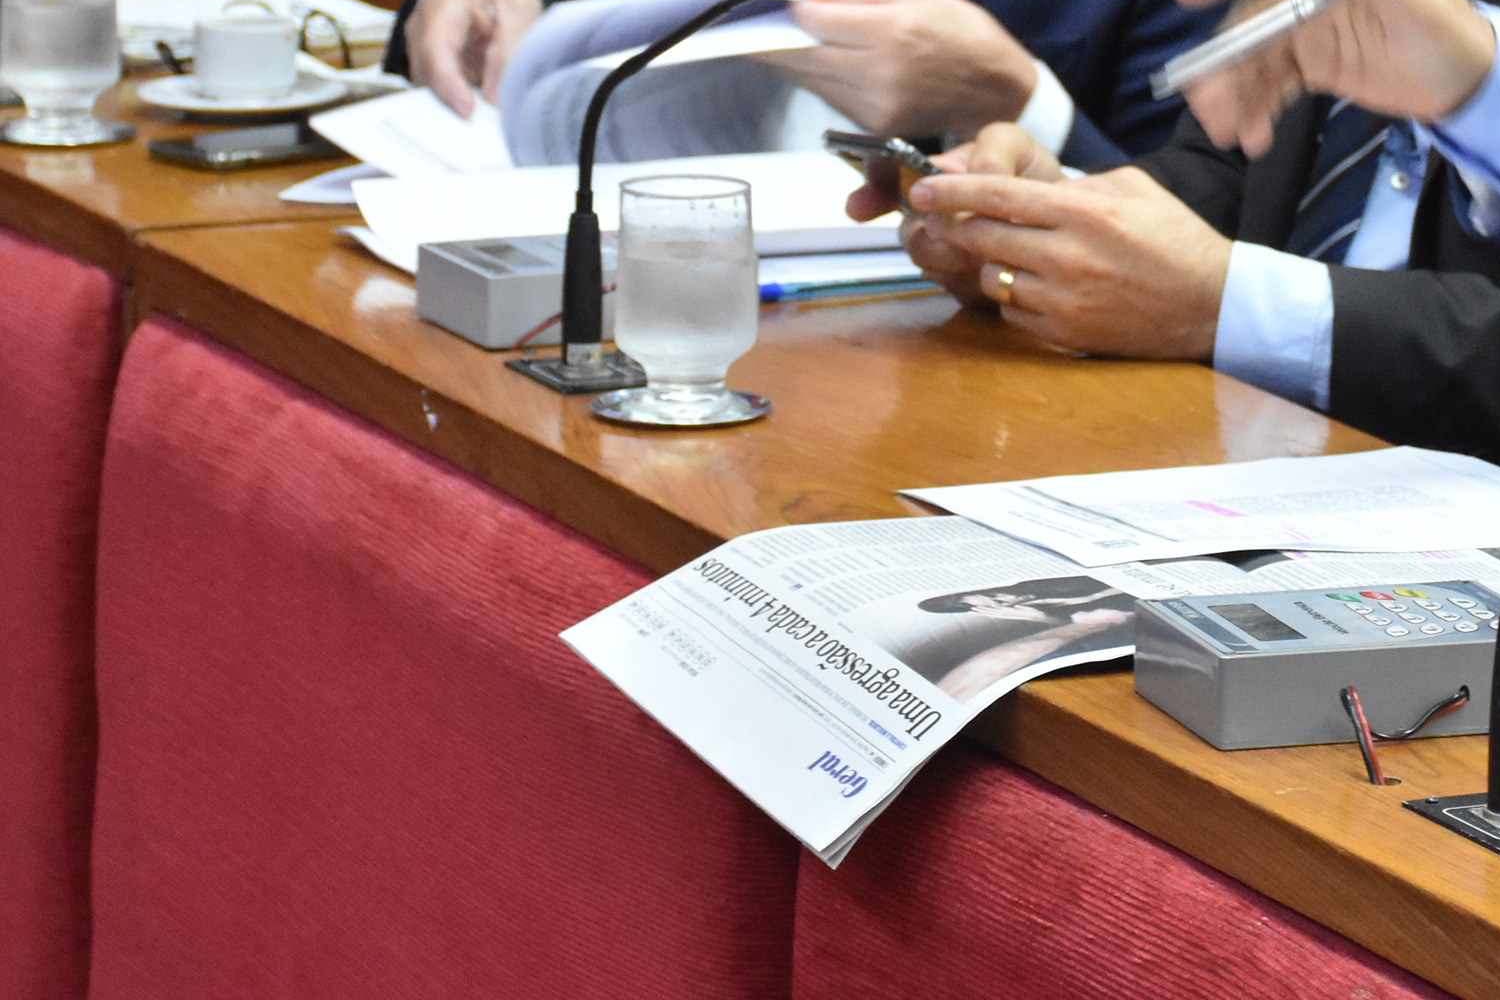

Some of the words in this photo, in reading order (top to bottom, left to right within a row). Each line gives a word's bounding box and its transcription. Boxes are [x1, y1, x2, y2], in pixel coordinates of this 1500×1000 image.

[694, 559, 770, 607] minutos
[750, 598, 777, 617] 4
[766, 605, 817, 640] cada
[805, 630, 828, 648] a
[816, 640, 900, 700] agressão
[888, 689, 941, 741] Uma
[808, 751, 867, 798] Geral
